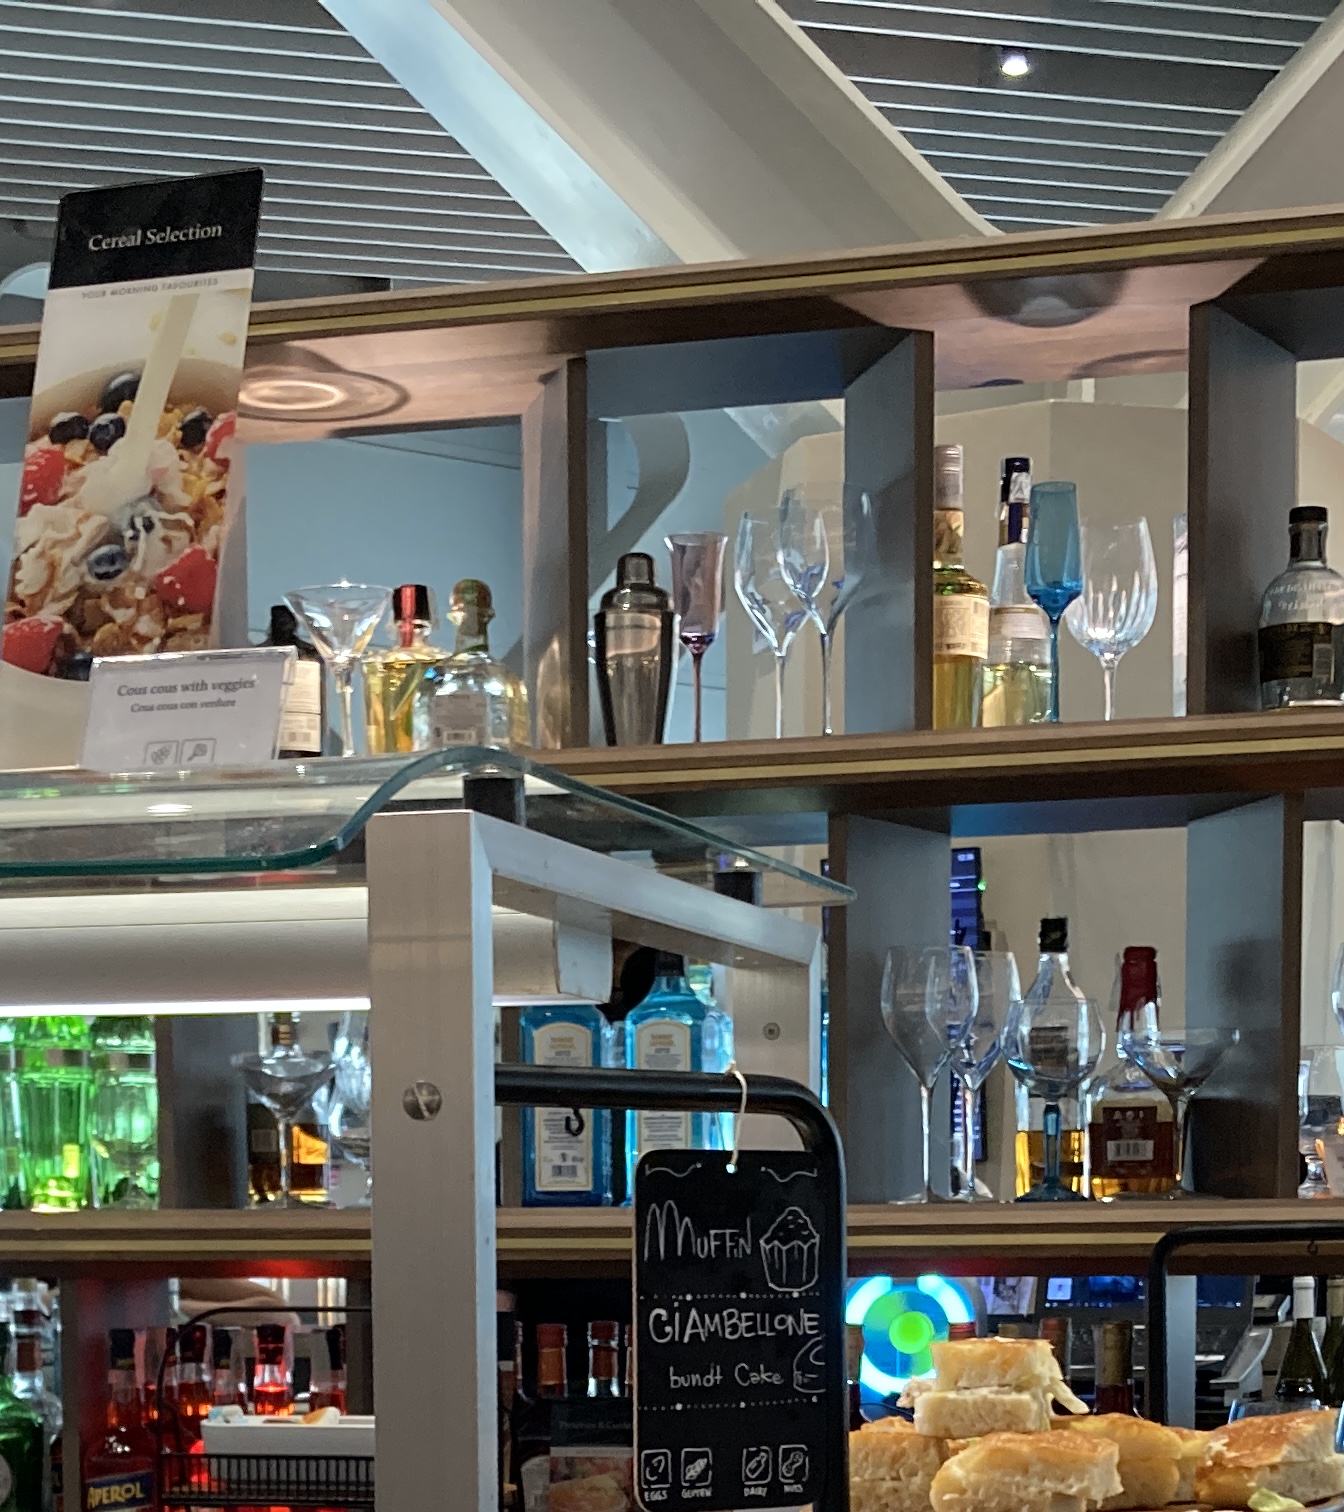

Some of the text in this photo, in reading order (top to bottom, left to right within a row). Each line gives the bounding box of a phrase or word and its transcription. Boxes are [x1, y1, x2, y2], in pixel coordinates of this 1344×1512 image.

[88, 223, 222, 251] Cereal Selection
[117, 678, 255, 697] Cous cous with veggies
[669, 1362, 784, 1389] bundt Cake
[87, 1482, 145, 1510] APEROL
[644, 1490, 668, 1502] EGGS
